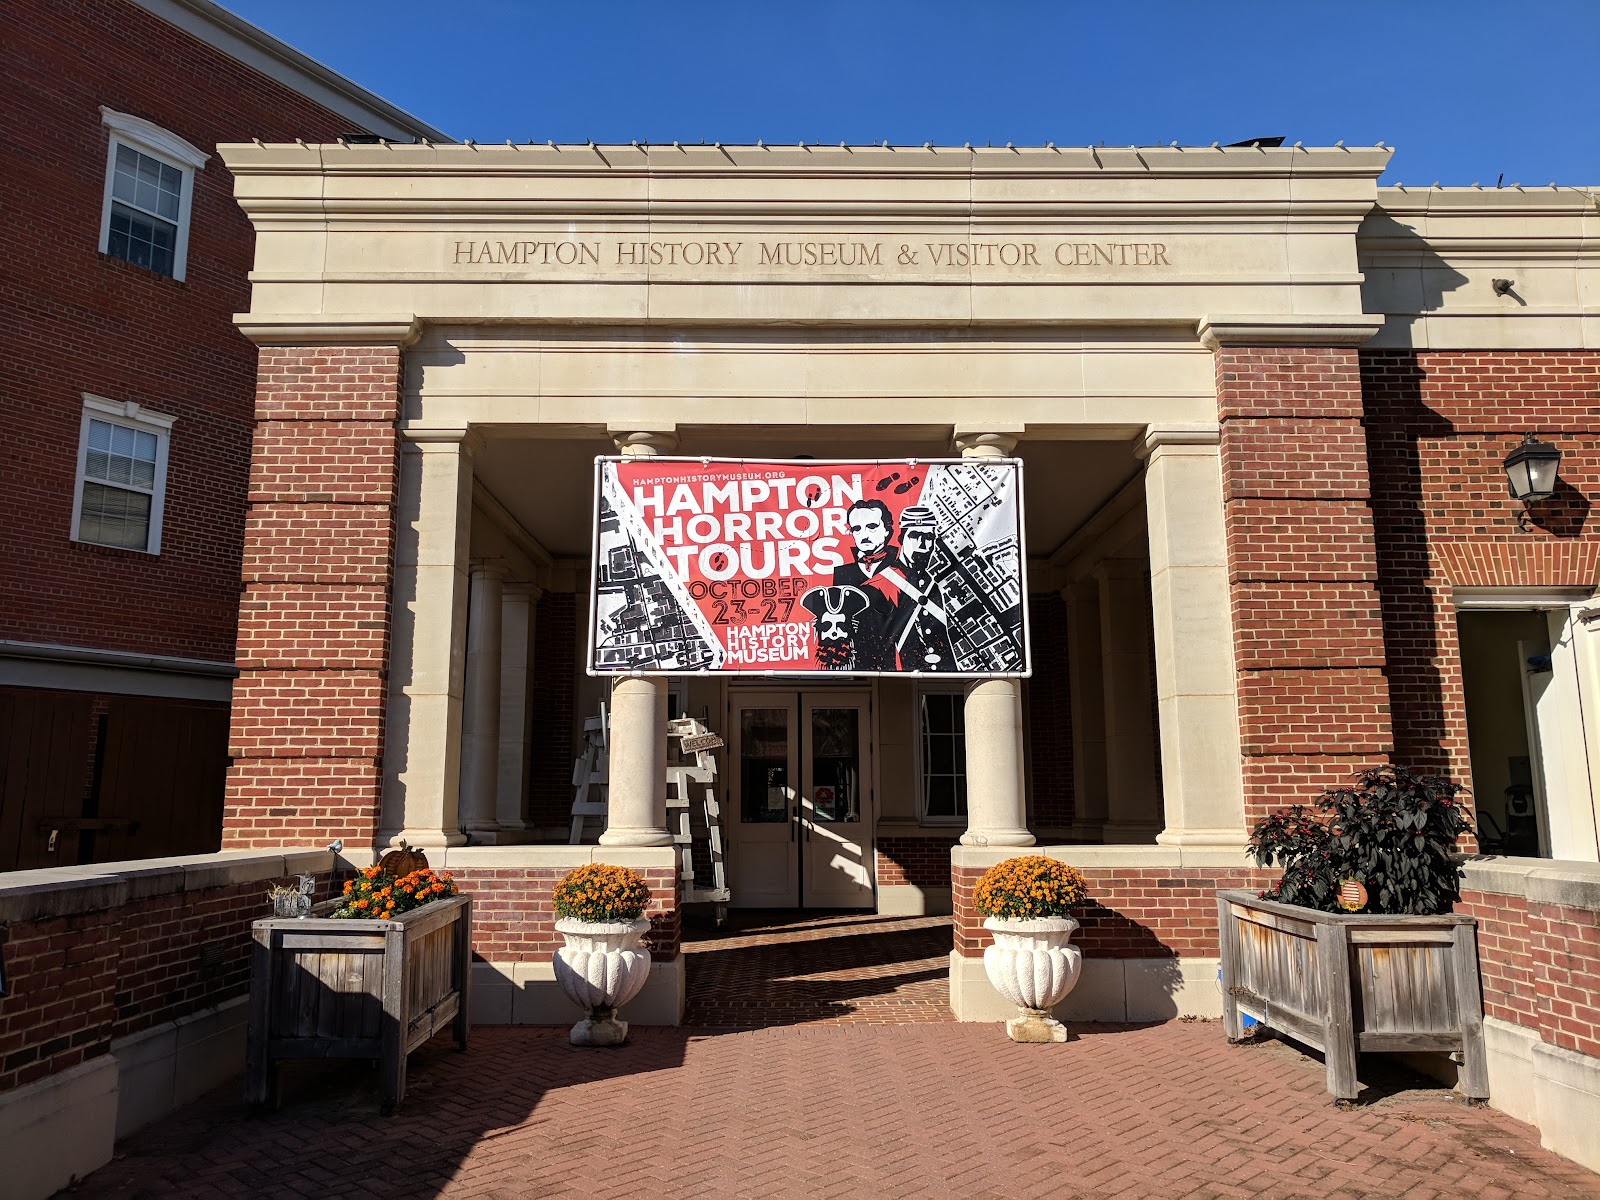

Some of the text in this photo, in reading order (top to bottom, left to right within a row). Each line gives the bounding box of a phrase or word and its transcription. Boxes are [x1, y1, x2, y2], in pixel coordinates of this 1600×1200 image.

[453, 240, 1171, 266] HAMPTON HISTORY MUSEUM & VISITOR CENTER
[632, 471, 785, 486] HAMPTONHISTORYMUSEUM.ORG
[633, 473, 863, 518] HAMPTON
[653, 507, 852, 546] HORROR
[666, 537, 845, 582] TOURS
[688, 577, 808, 600] OCTOBER
[711, 597, 796, 626] 23-27
[726, 622, 811, 640] HAMPTON
[727, 634, 811, 651] HISTORY
[727, 646, 809, 665] MUSEUM
